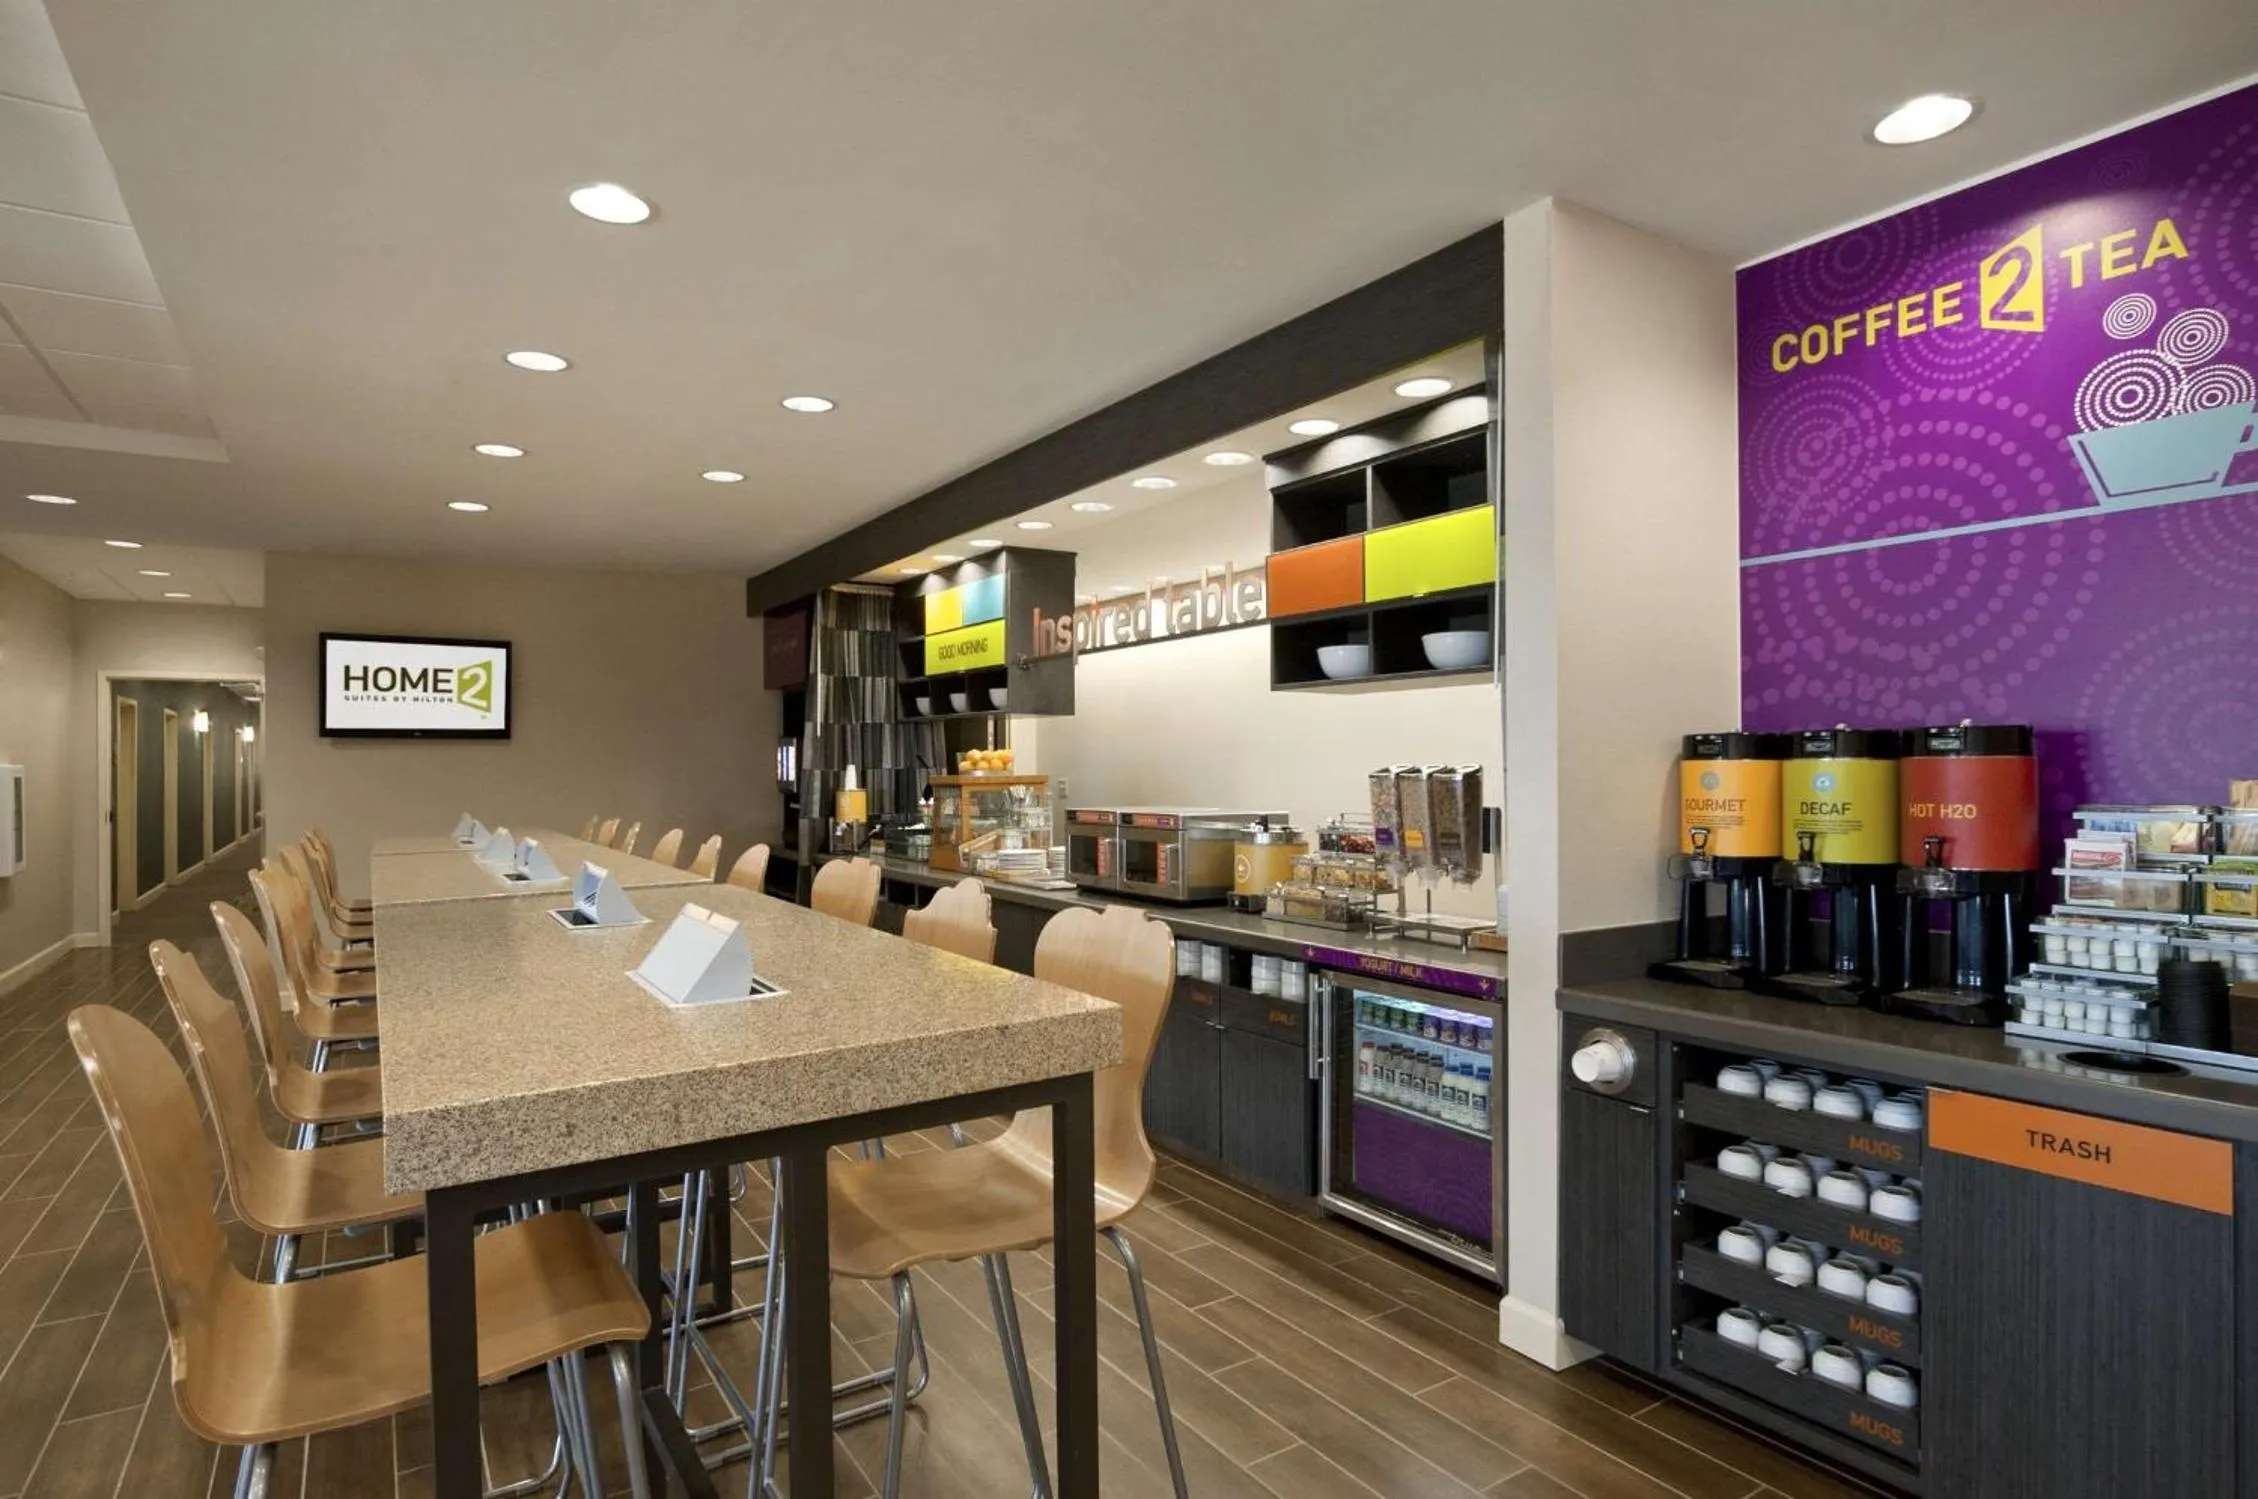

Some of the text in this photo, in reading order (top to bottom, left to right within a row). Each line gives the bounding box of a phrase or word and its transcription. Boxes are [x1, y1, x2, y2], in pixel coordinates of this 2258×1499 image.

[1771, 218, 2190, 373] COFFEE 2 TEA
[1033, 560, 1262, 665] Inspired table
[344, 695, 387, 703] SUITES
[413, 696, 453, 704] HILTON
[1800, 801, 1853, 816] DECAF
[1908, 803, 1936, 818] HOT
[1849, 1134, 1903, 1164] MUGS
[2025, 1128, 2112, 1165] TRASH
[1849, 1225, 1903, 1255] MUGS
[1849, 1314, 1903, 1347] MUGS
[1849, 1411, 1903, 1445] MUGS
